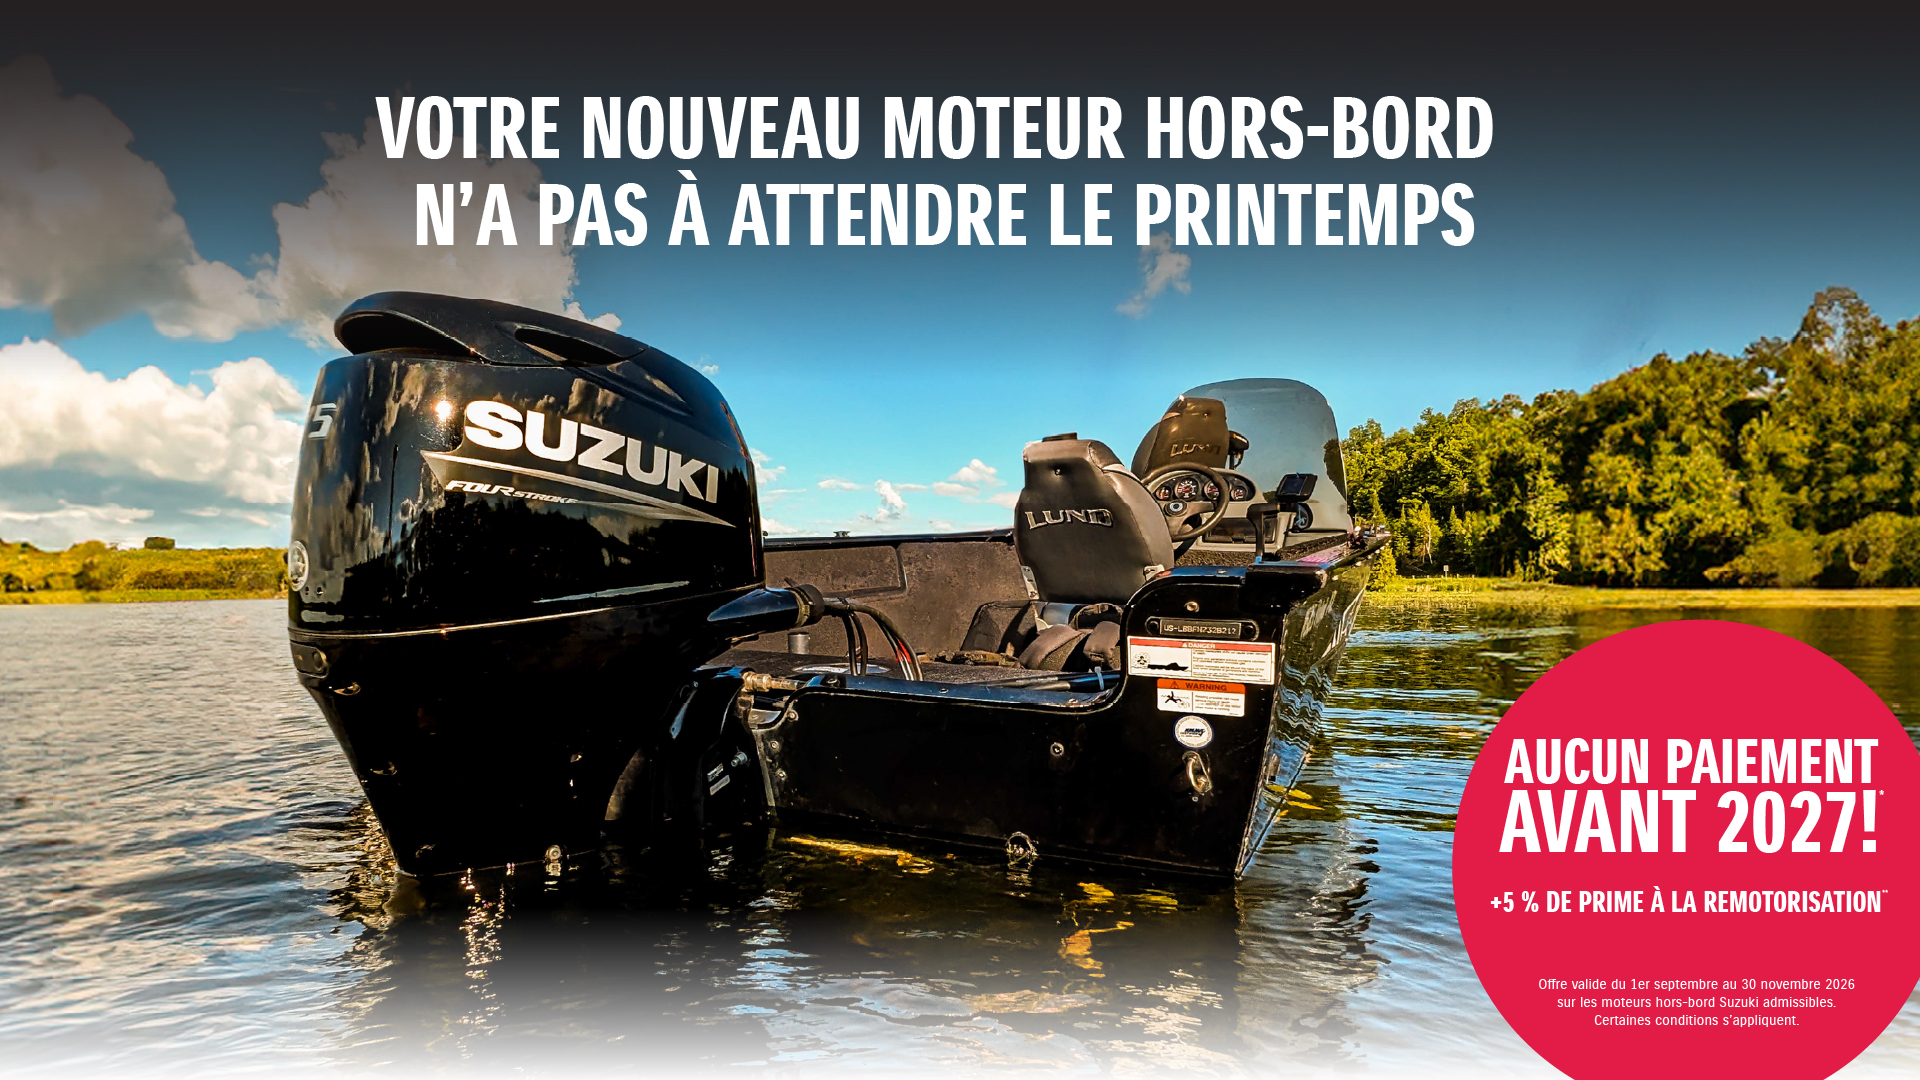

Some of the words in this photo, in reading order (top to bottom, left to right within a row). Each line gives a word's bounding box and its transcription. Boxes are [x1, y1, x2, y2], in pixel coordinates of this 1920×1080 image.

[308, 402, 338, 439] 5
[465, 400, 720, 504] SUZUKI
[1025, 507, 1114, 530] LUND
[1188, 642, 1216, 650] DANGER
[1185, 682, 1227, 691] WARNING
